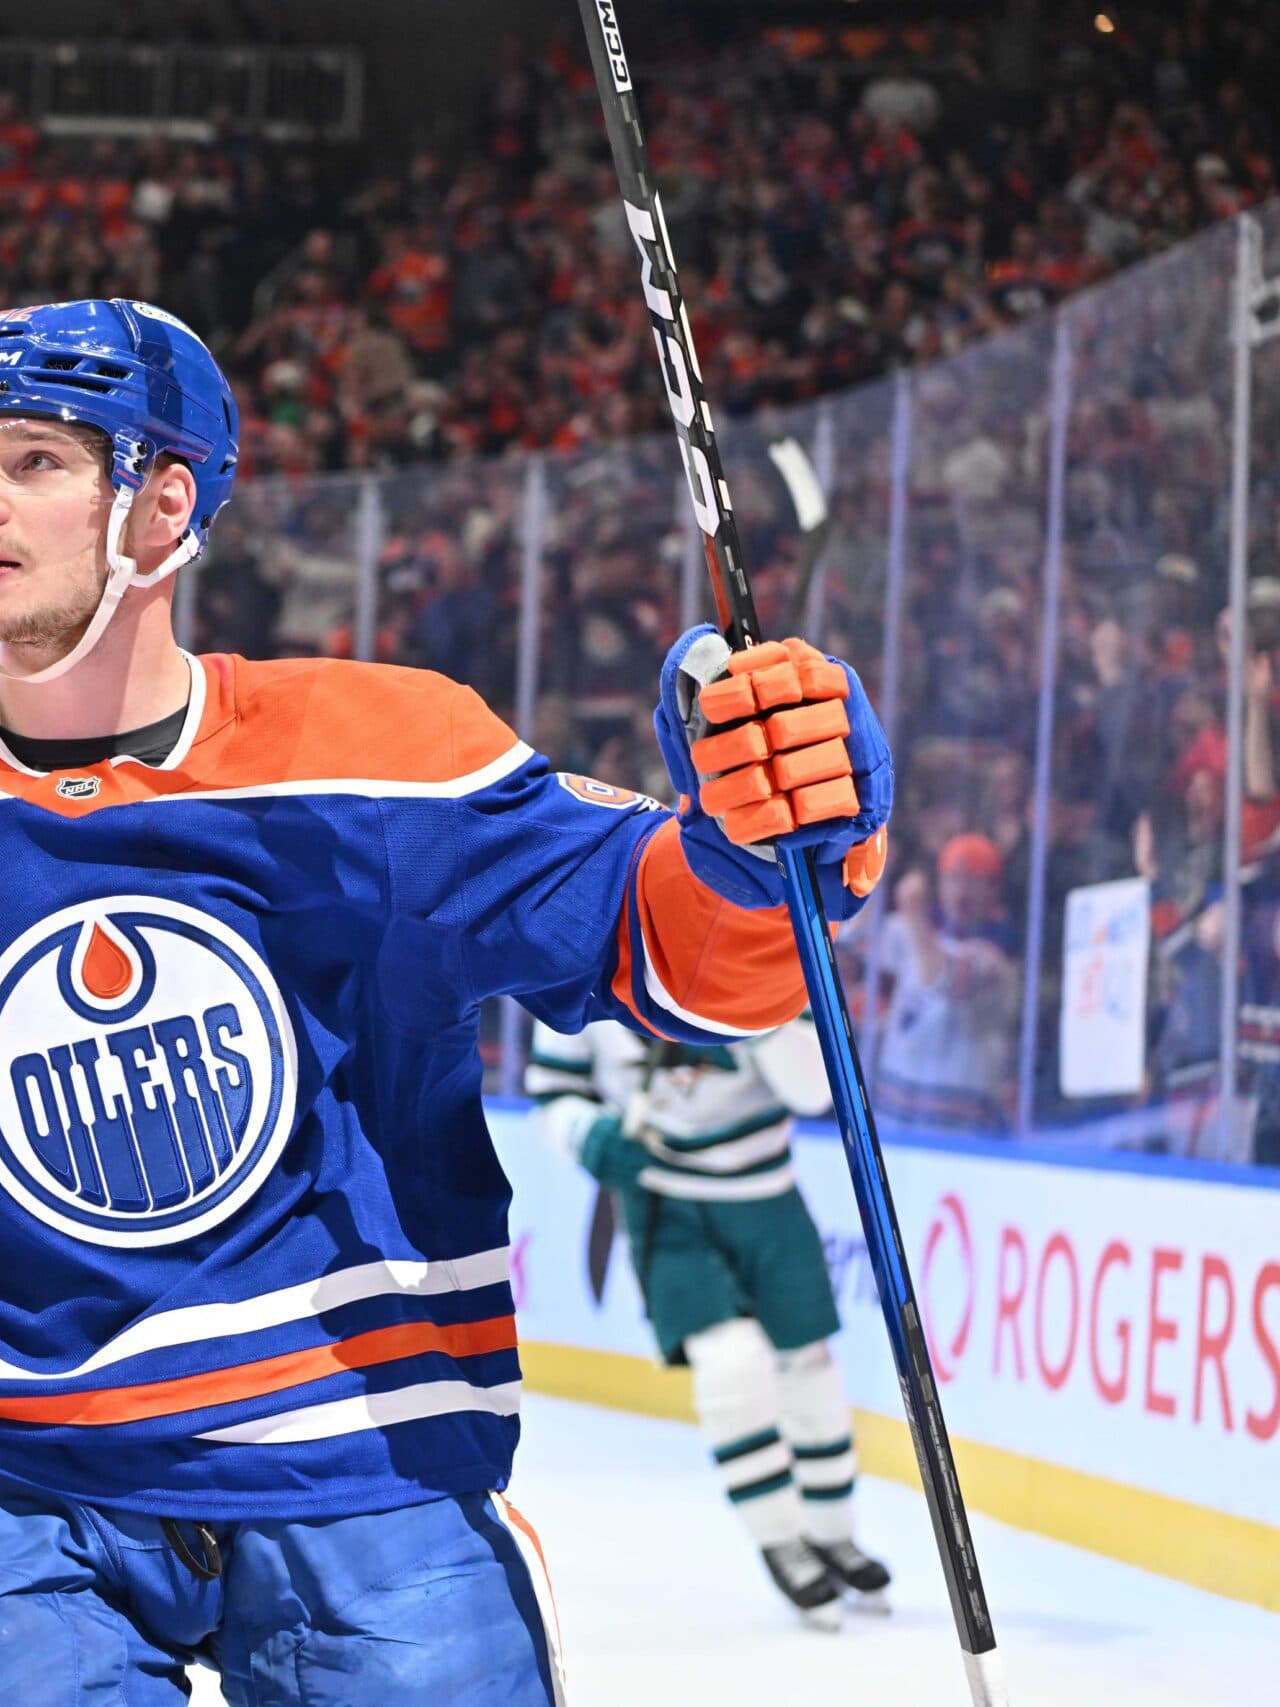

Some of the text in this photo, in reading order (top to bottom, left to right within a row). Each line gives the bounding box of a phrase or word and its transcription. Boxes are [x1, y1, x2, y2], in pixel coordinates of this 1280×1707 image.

[594, 0, 629, 84] CCM
[9, 1002, 255, 1214] OILERS
[992, 1225, 1280, 1442] ROGERS
